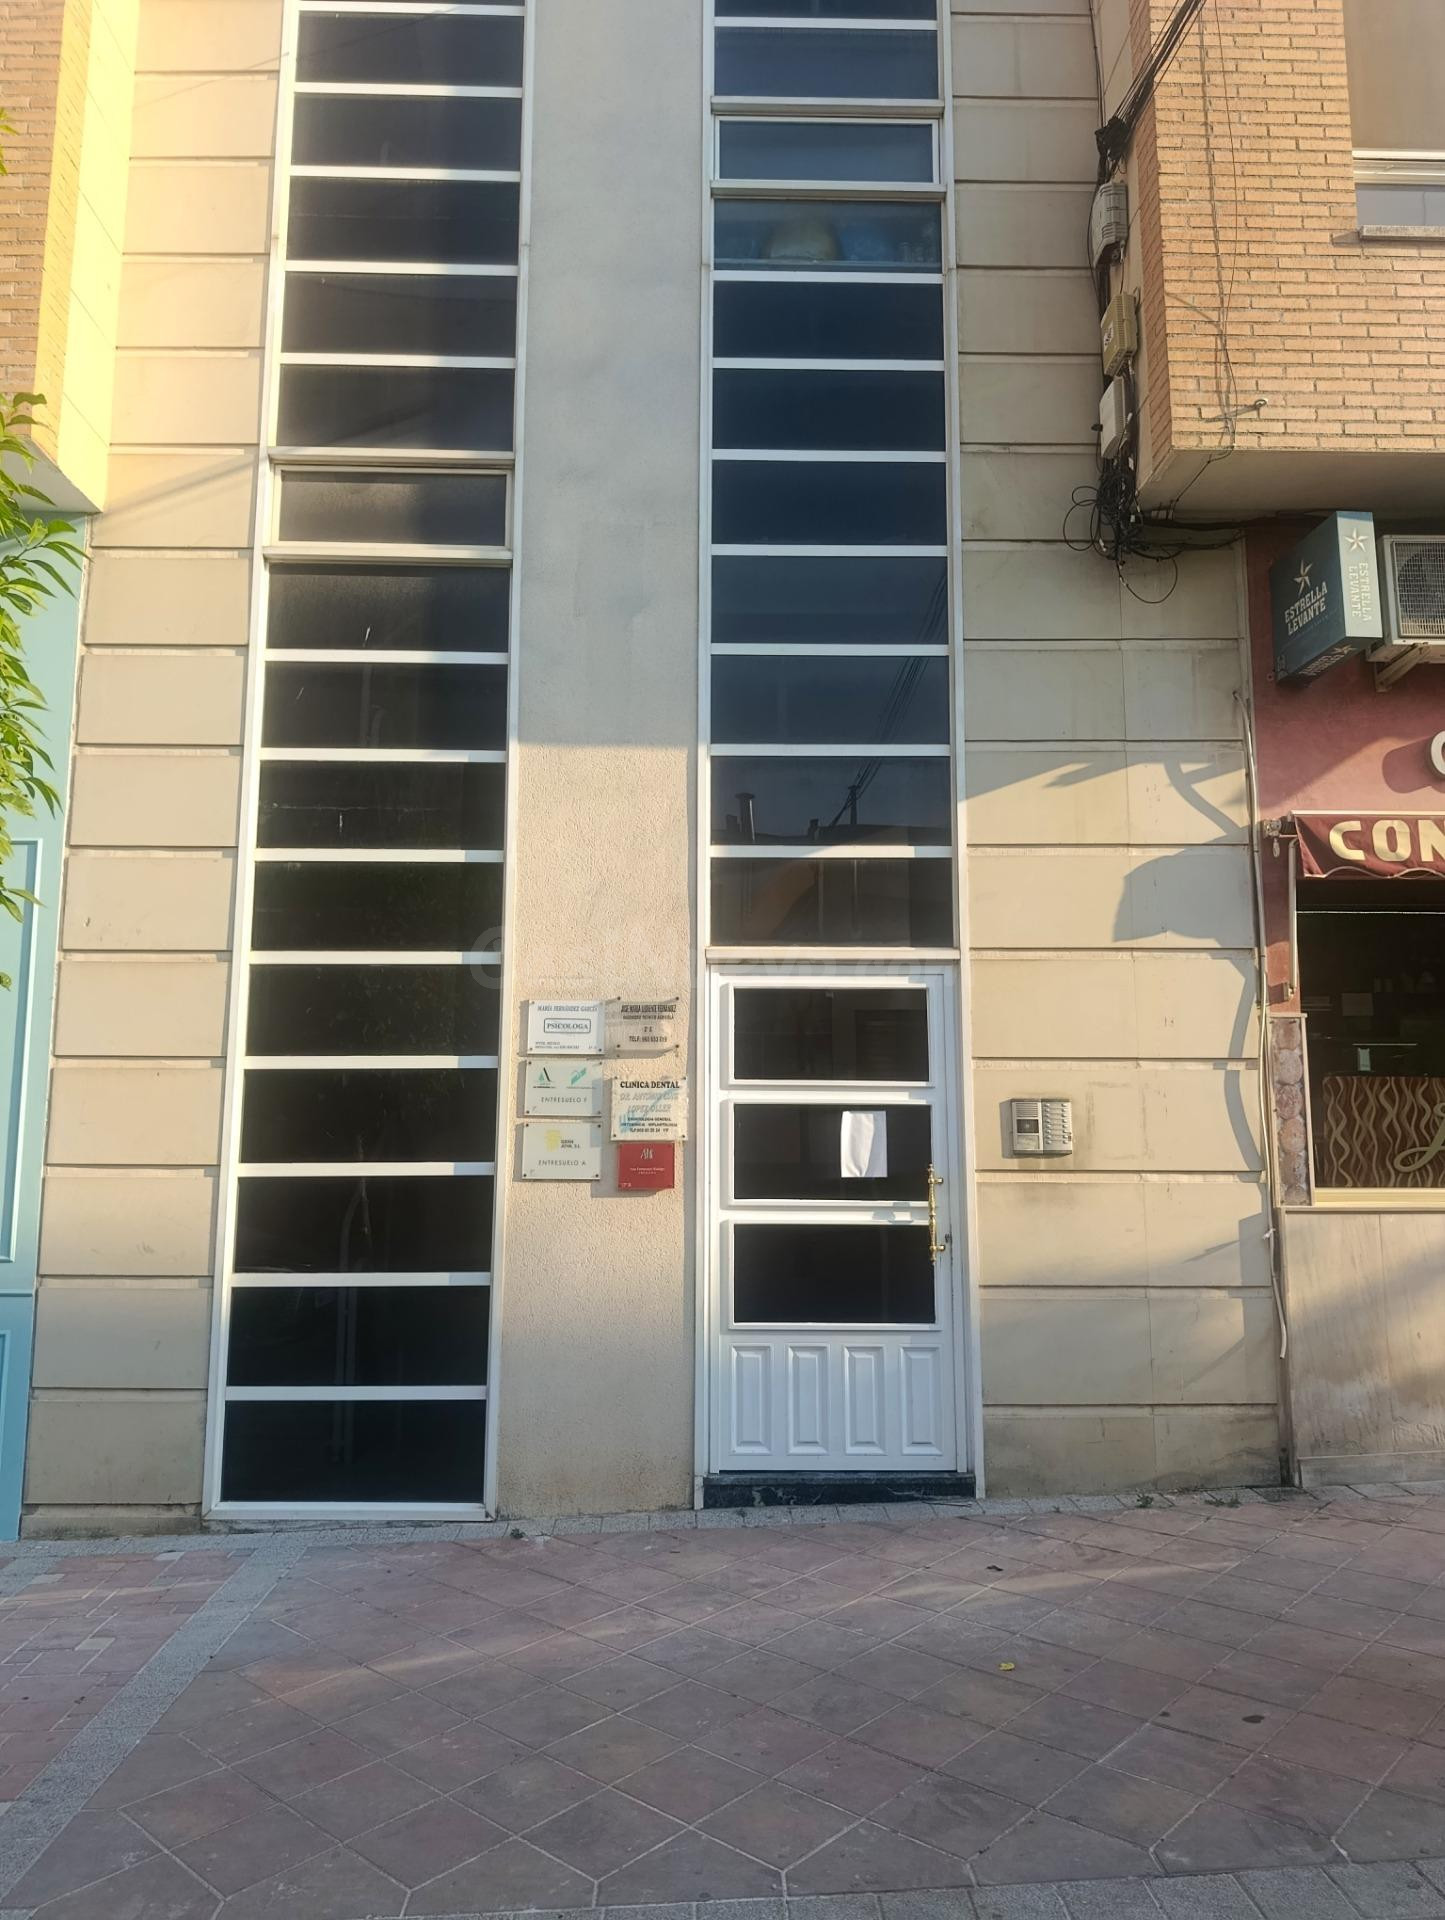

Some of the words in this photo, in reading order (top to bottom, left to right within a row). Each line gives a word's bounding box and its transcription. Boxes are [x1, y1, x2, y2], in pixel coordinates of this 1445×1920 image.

[1284, 581, 1328, 624] ESTRELLA
[1348, 566, 1361, 617] LEVANTE
[1359, 562, 1372, 621] ESTRELLA
[1288, 597, 1326, 636] LEVANTE
[651, 1081, 680, 1089] DENTAL
